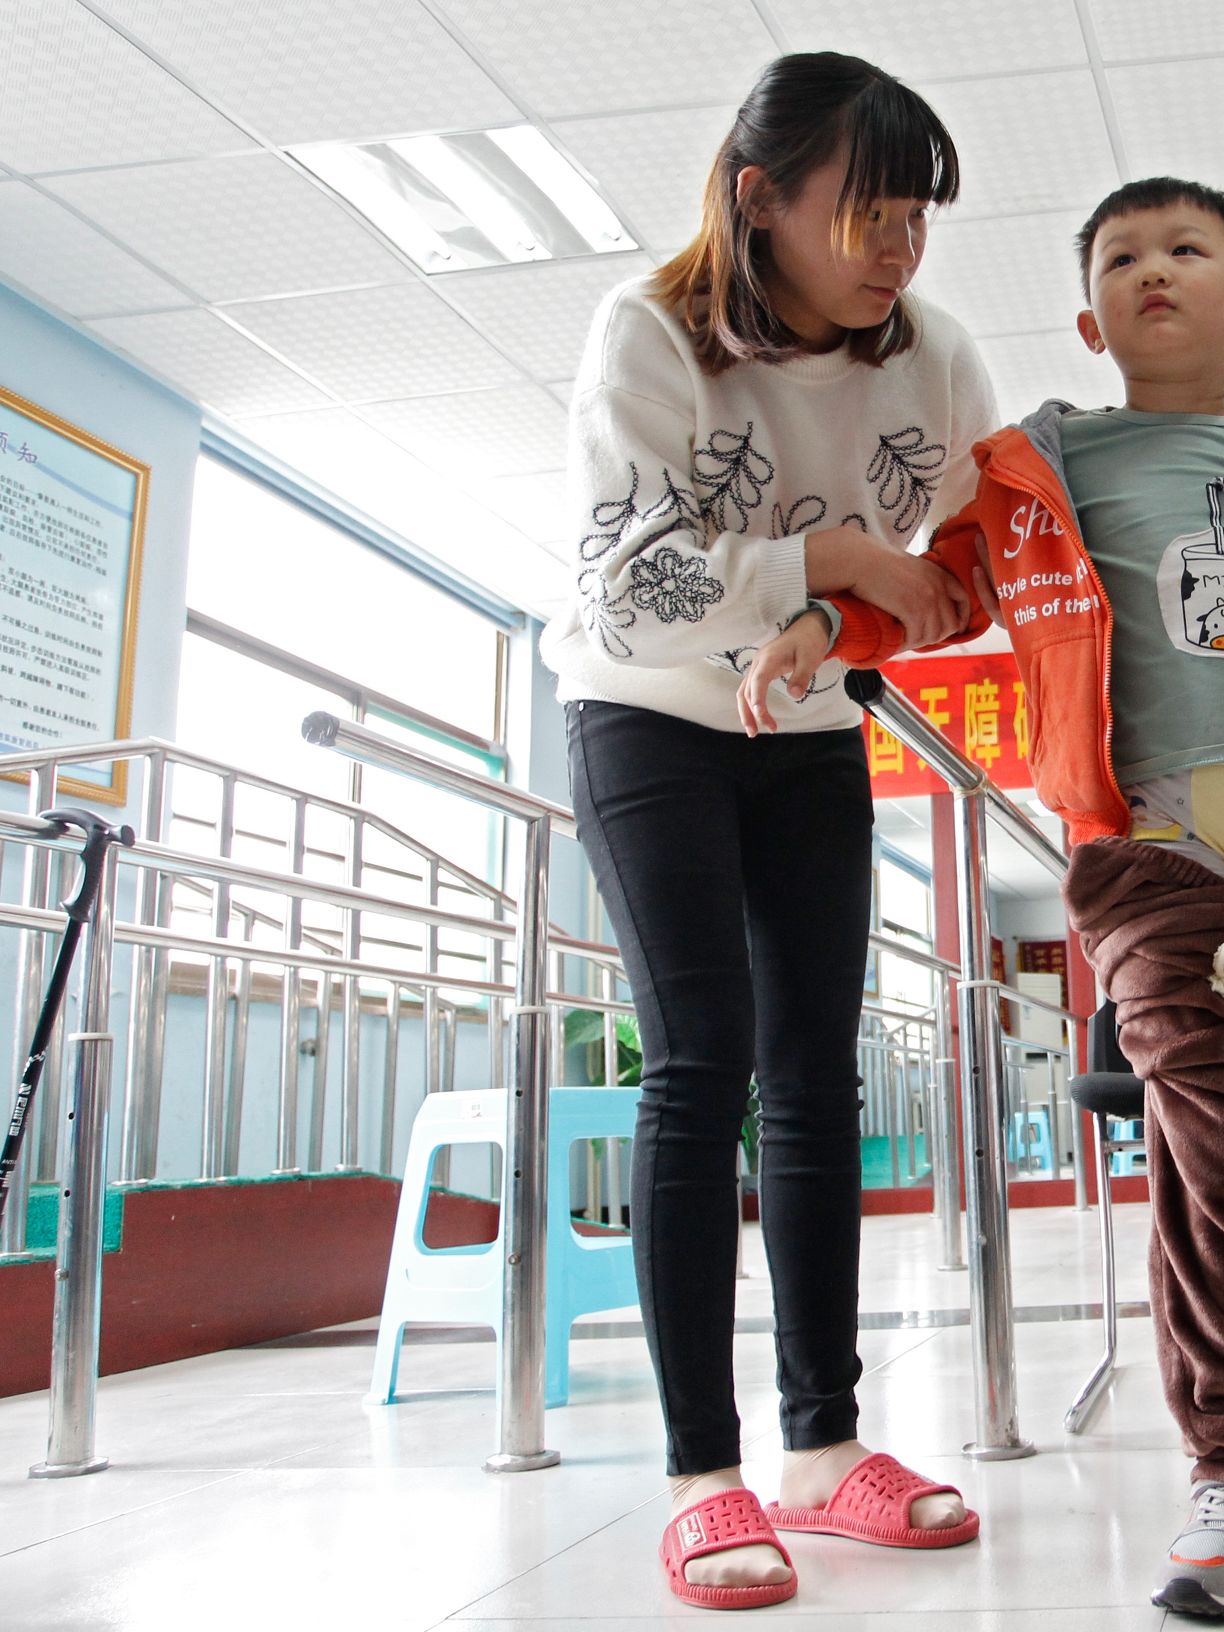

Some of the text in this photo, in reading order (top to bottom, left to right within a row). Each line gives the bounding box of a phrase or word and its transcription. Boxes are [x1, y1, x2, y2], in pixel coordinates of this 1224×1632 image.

[997, 571, 1073, 600] style cute
[1013, 605, 1037, 627] this
[1041, 598, 1061, 617] of
[1065, 596, 1092, 614] the
